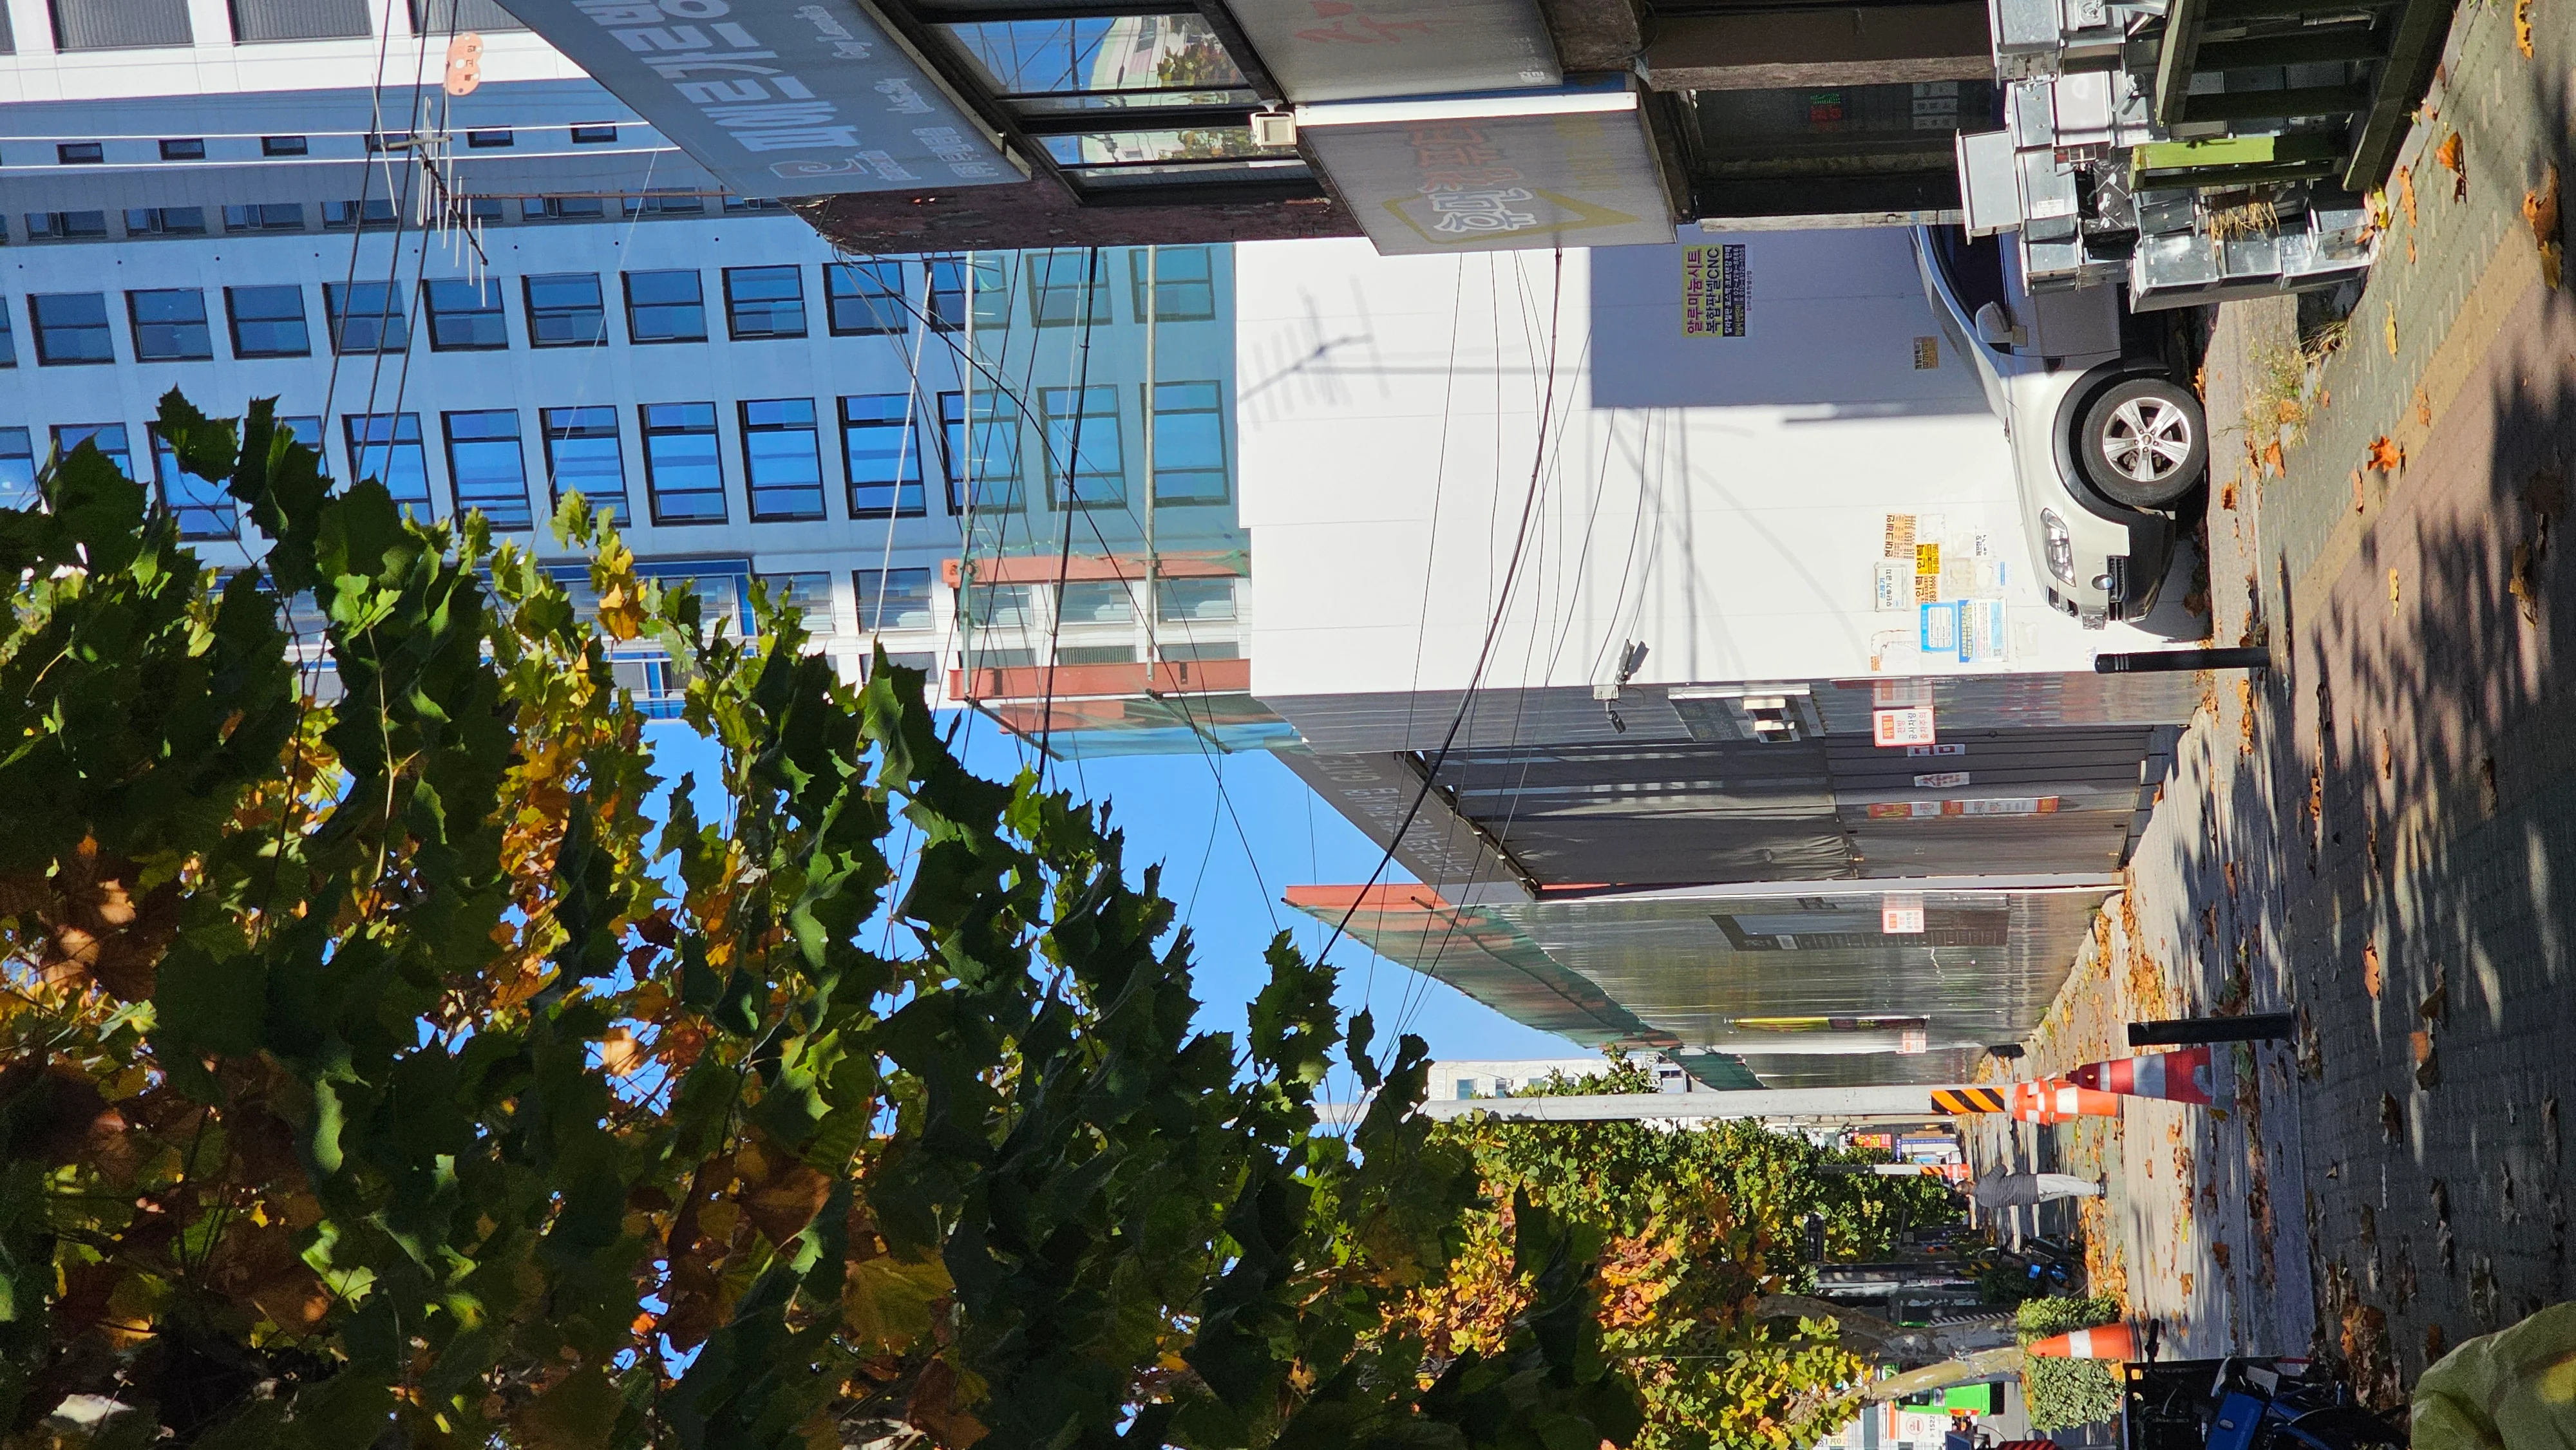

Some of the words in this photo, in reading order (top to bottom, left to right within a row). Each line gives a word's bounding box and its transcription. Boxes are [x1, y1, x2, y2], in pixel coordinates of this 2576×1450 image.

[1687, 249, 1703, 334] 알루미늄시트
[1885, 514, 1895, 557] 현대크레인
[1917, 545, 1925, 569] 인력
[1886, 569, 1892, 581] 금지
[1915, 576, 1924, 597] 인력
